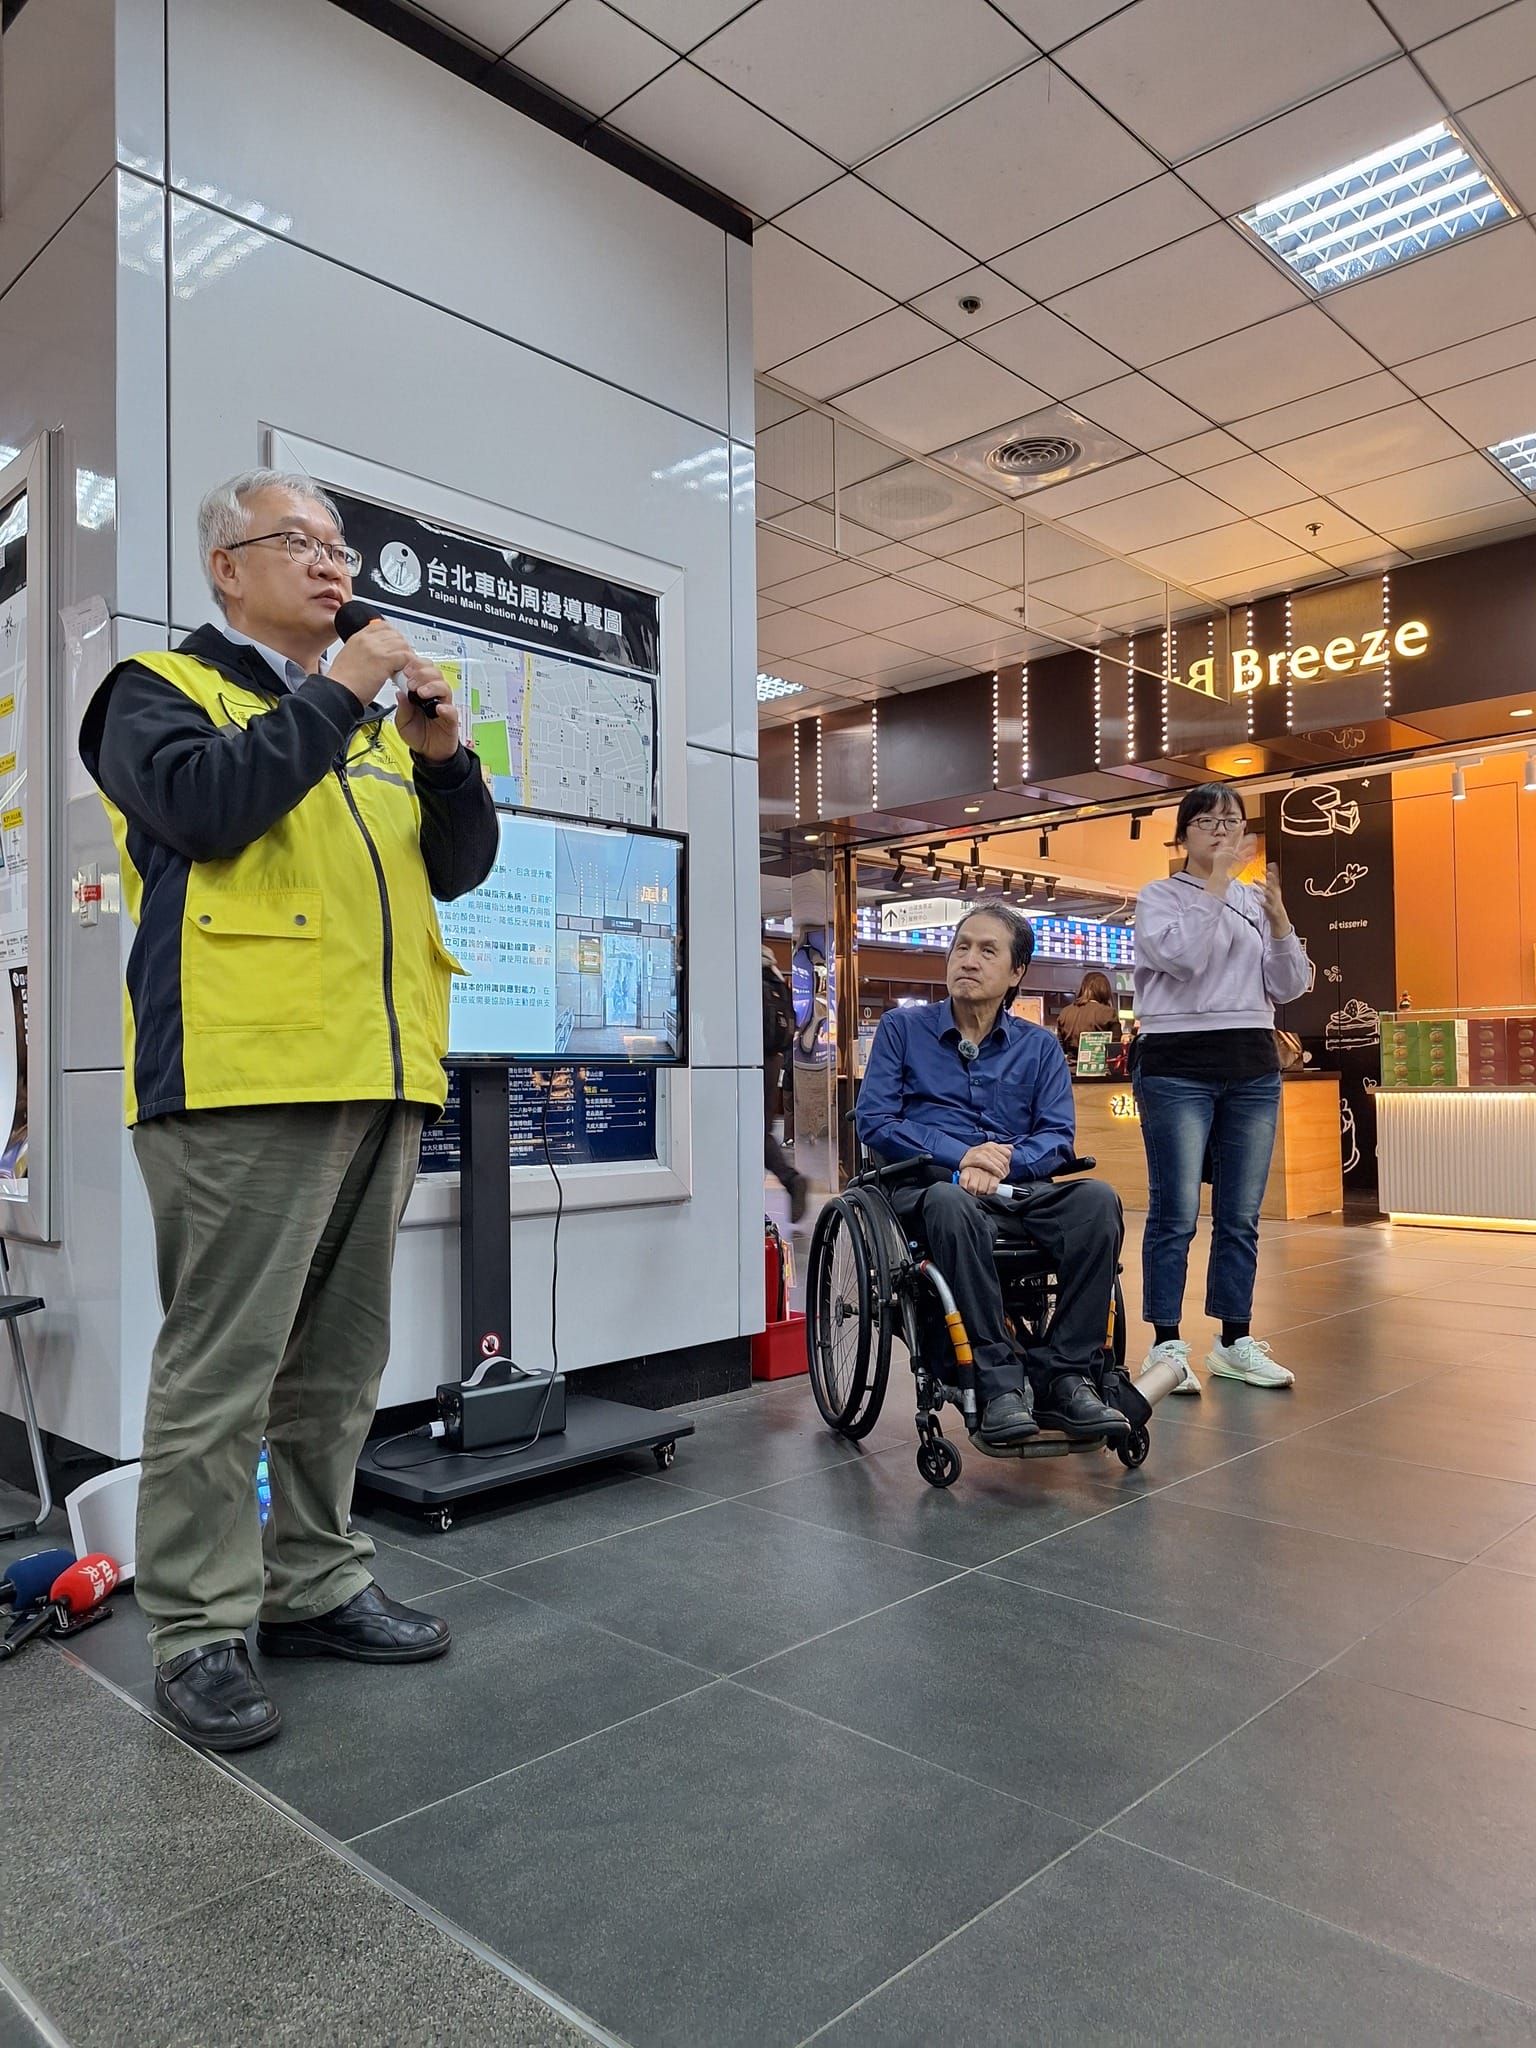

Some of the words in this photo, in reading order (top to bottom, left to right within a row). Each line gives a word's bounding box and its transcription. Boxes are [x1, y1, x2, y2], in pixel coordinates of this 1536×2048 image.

[427, 557, 623, 636] 台北車站周邊導覽圖
[428, 587, 458, 605] Taipei
[460, 595, 482, 612] Main
[484, 603, 516, 621] Station
[518, 613, 539, 627] Area
[540, 619, 559, 633] Map
[1231, 619, 1430, 694] Breeze
[1110, 1095, 1138, 1116] 法
